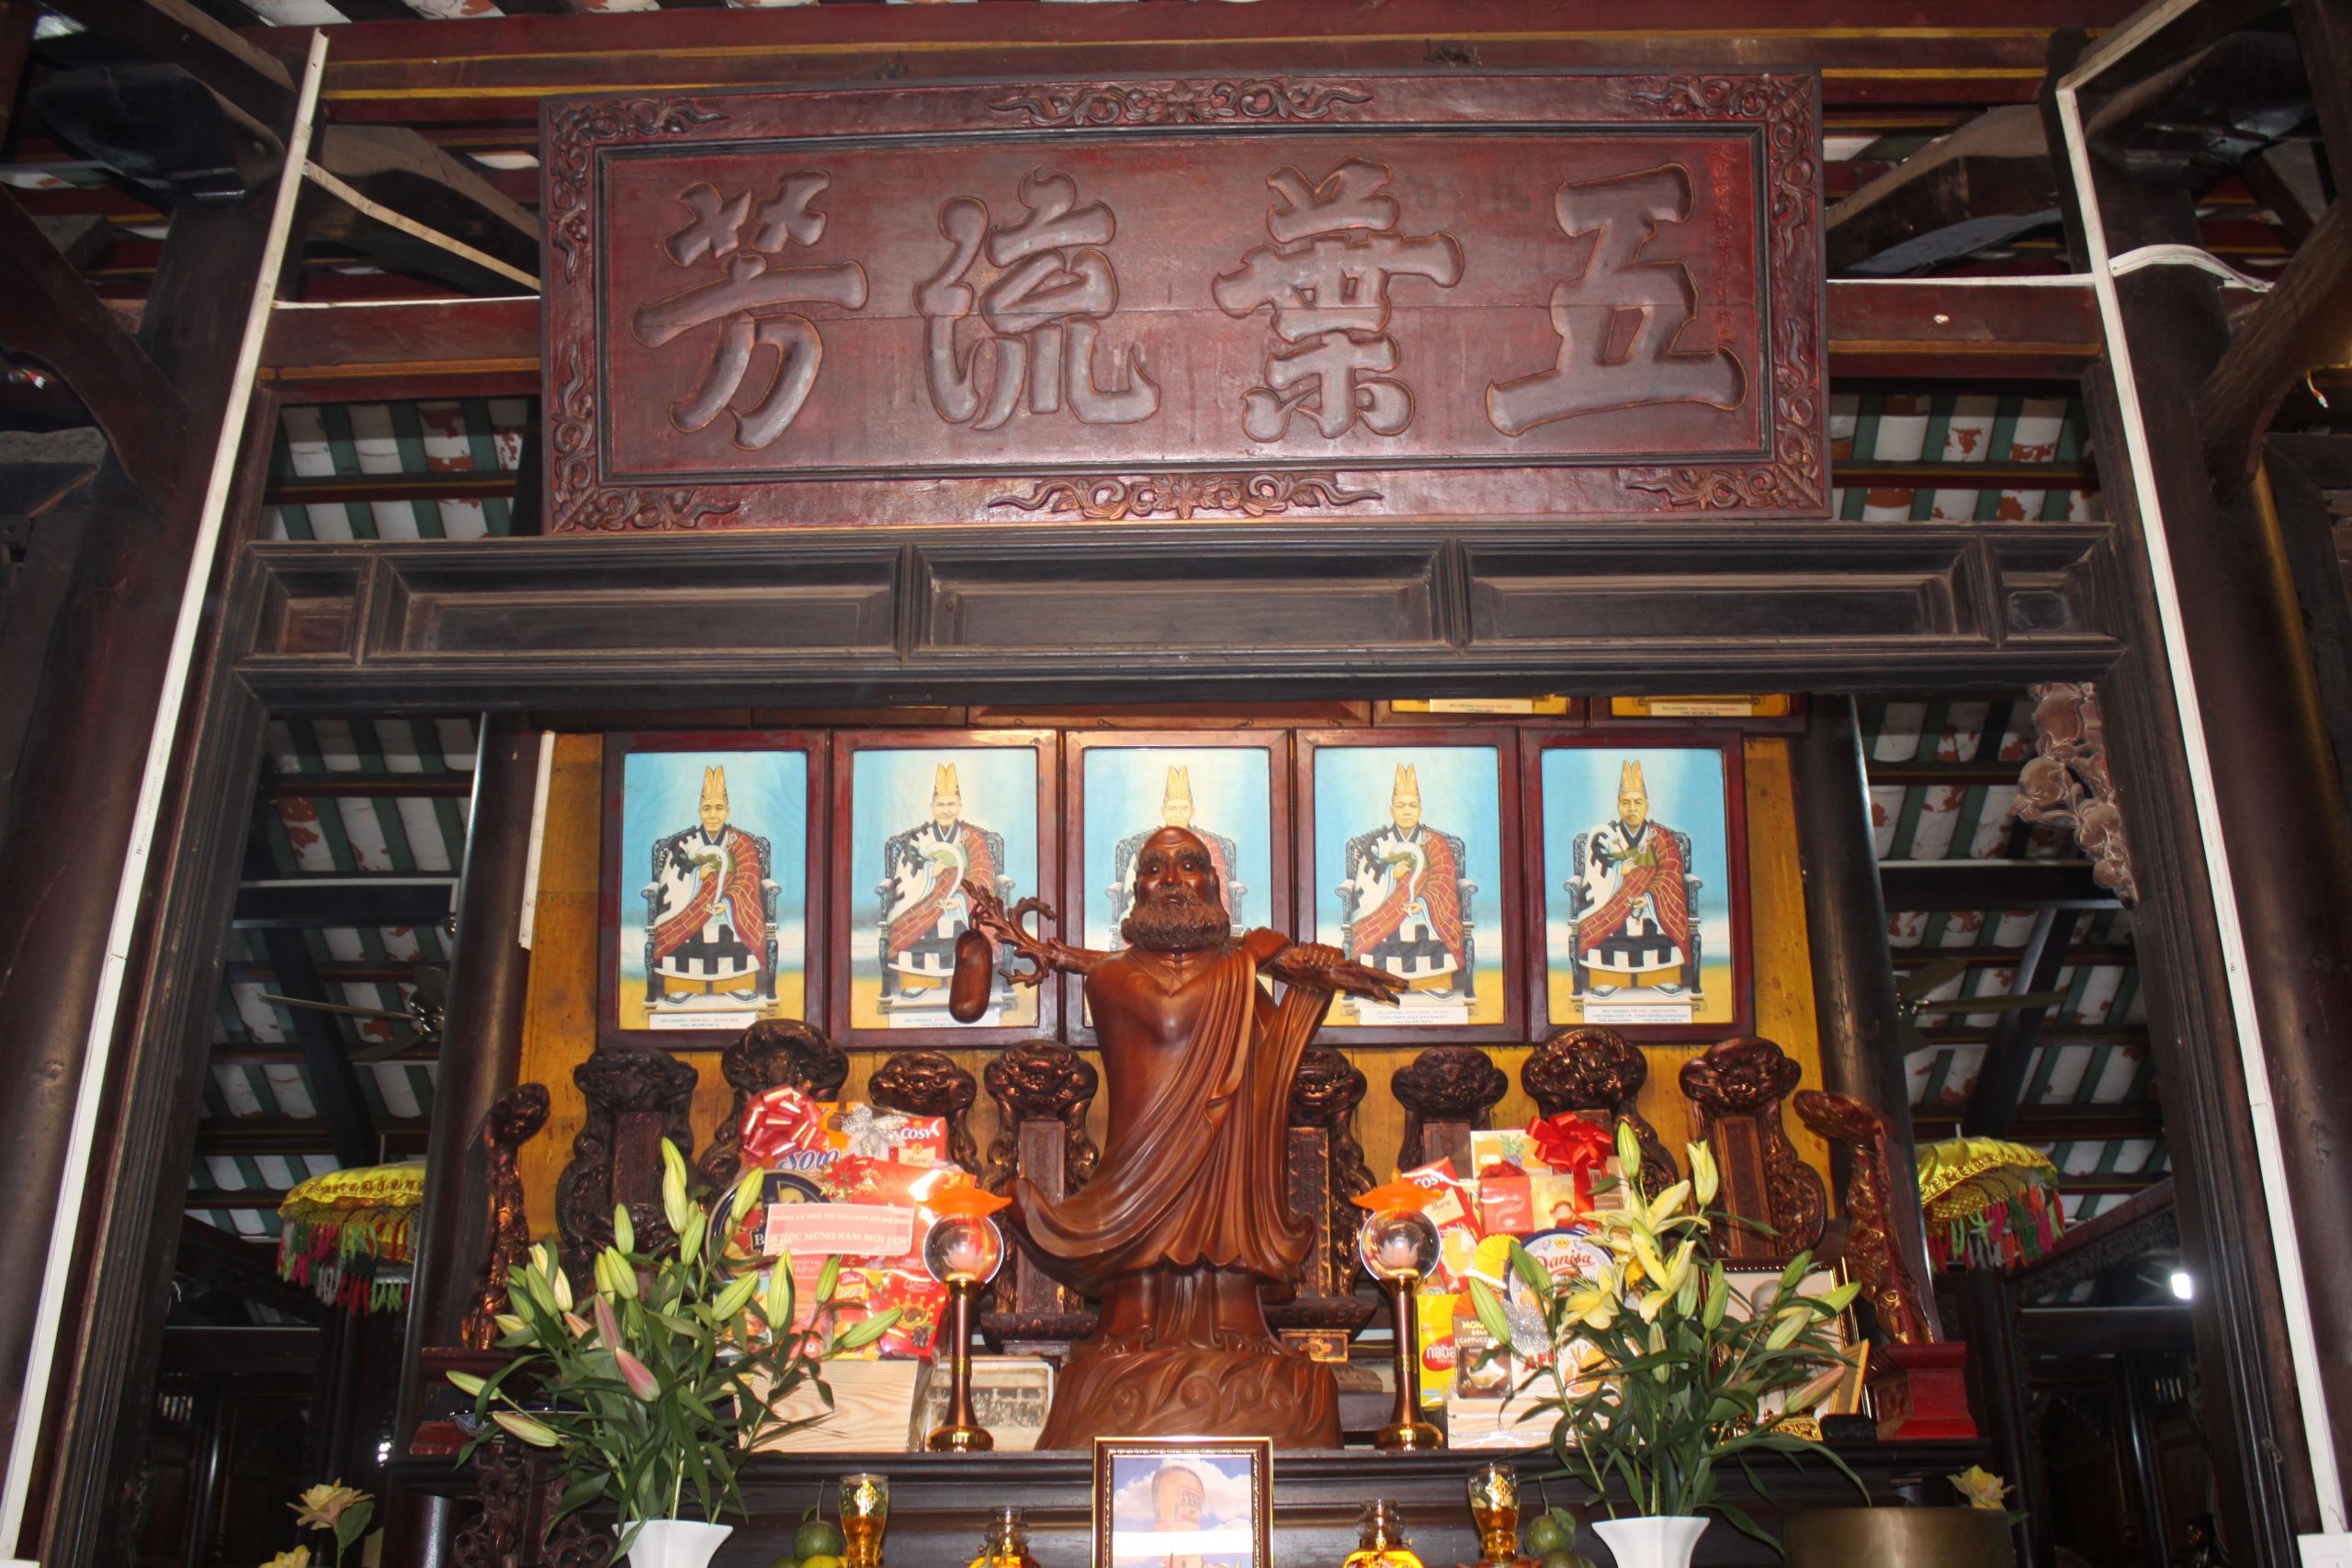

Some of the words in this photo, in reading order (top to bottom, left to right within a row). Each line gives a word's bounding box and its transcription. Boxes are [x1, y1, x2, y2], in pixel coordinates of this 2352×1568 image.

[900, 1128, 932, 1140] COSY
[837, 1231, 861, 1241] NĂM
[1426, 1344, 1456, 1359] naba
